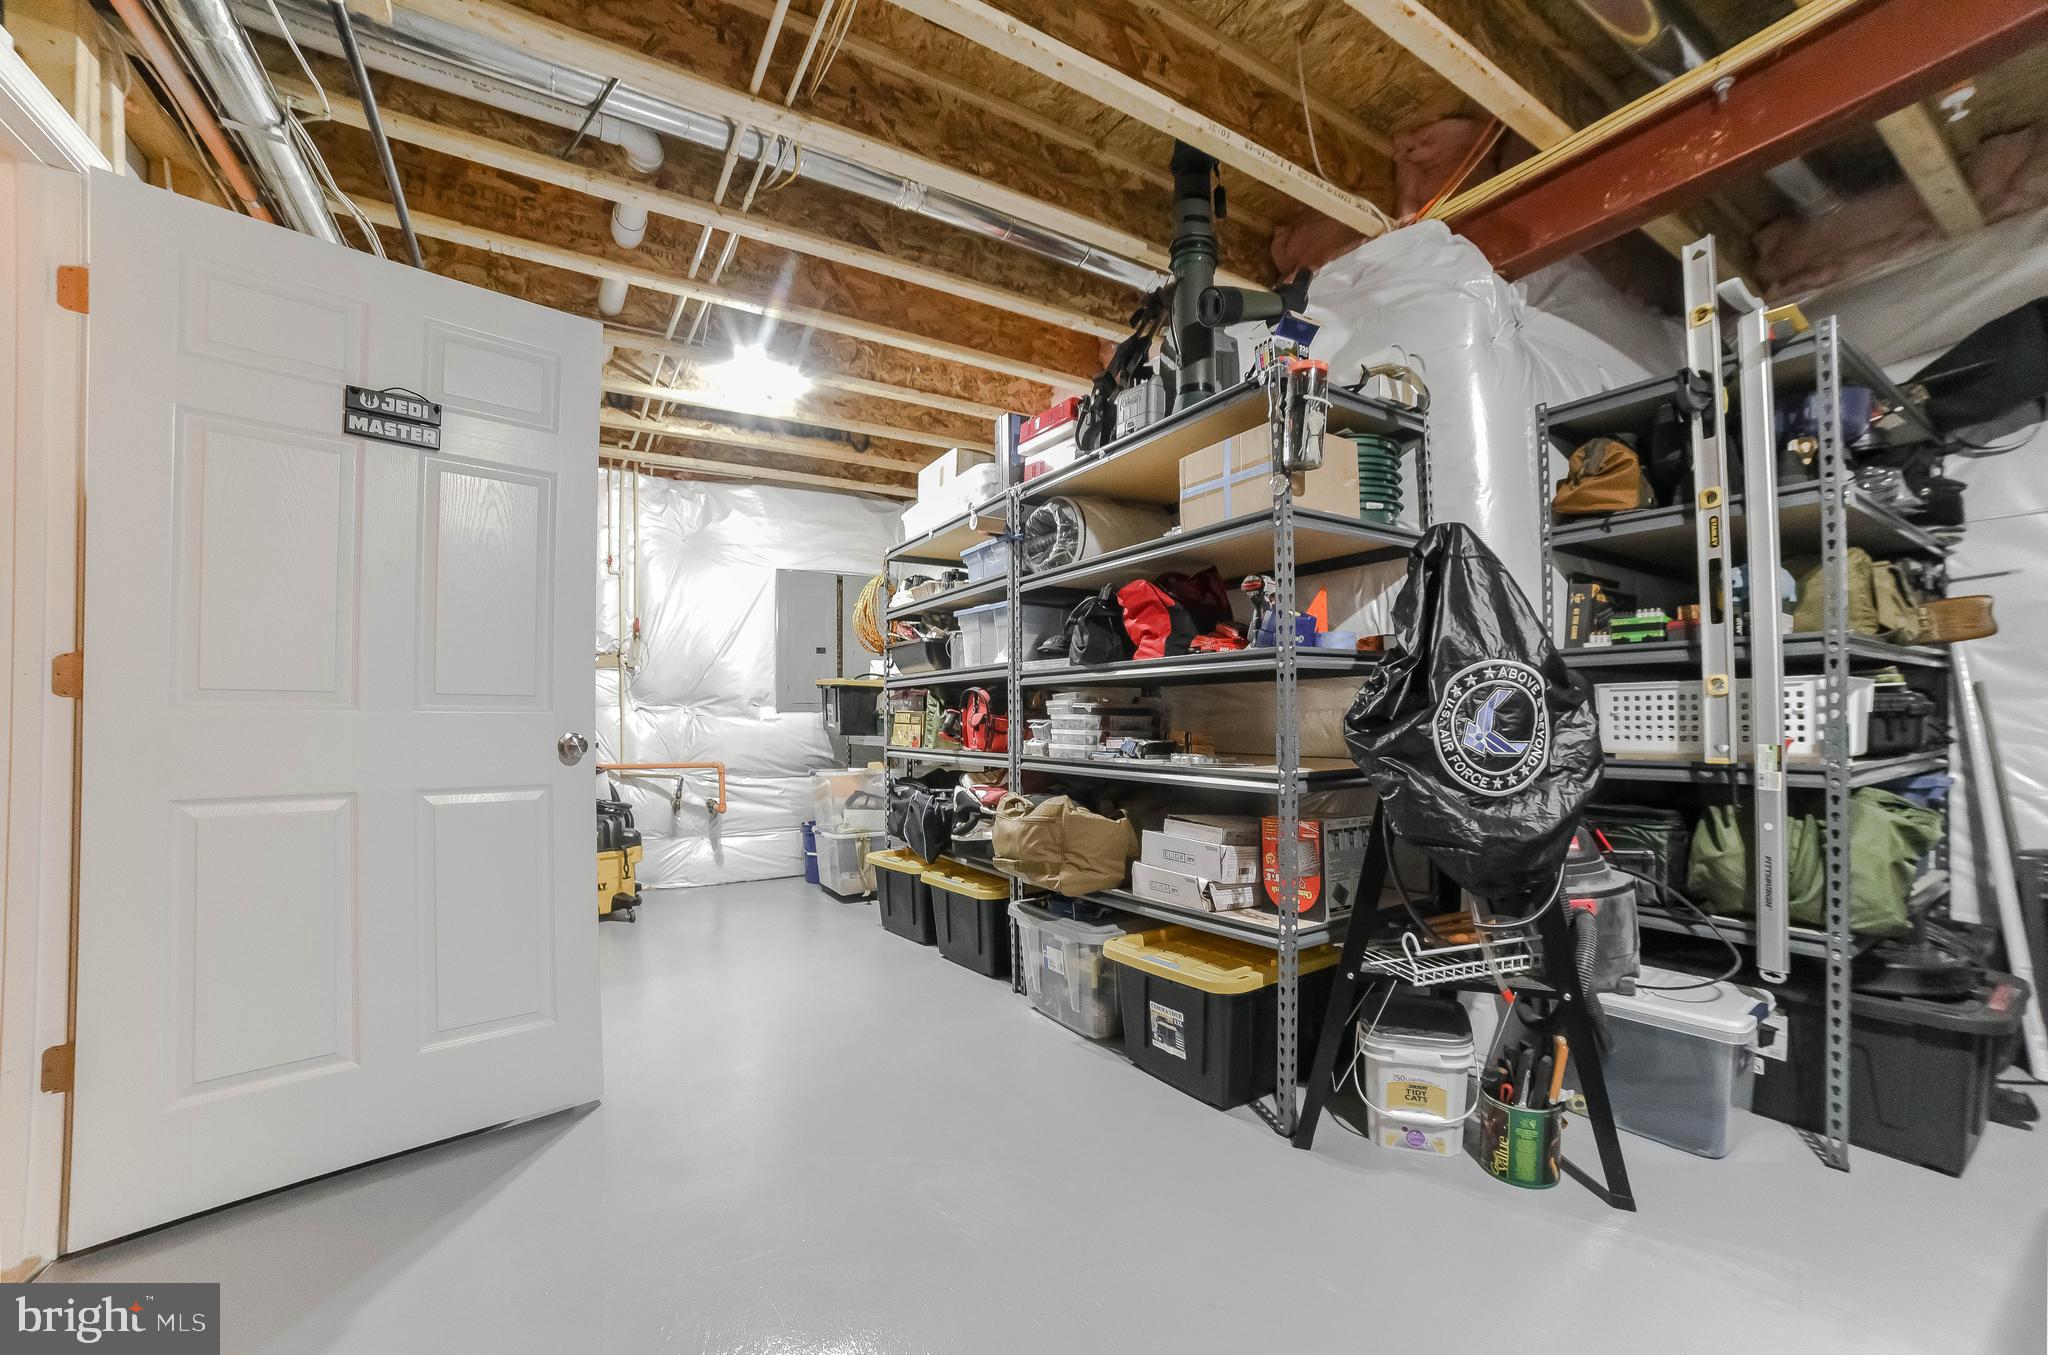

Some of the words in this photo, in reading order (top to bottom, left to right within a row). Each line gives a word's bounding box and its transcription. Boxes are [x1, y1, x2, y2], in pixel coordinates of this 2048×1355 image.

[382, 397, 428, 419] JEDI
[349, 414, 436, 444] MASTER
[1711, 517, 1719, 546] STANLEY
[1498, 666, 1540, 696] ABOVE
[1440, 729, 1455, 753] AIR
[1447, 755, 1490, 789] FORCE
[1765, 856, 1773, 910] PITTSBURGH
[1405, 1095, 1428, 1103] CATS
[1406, 1089, 1427, 1097] TIDY
